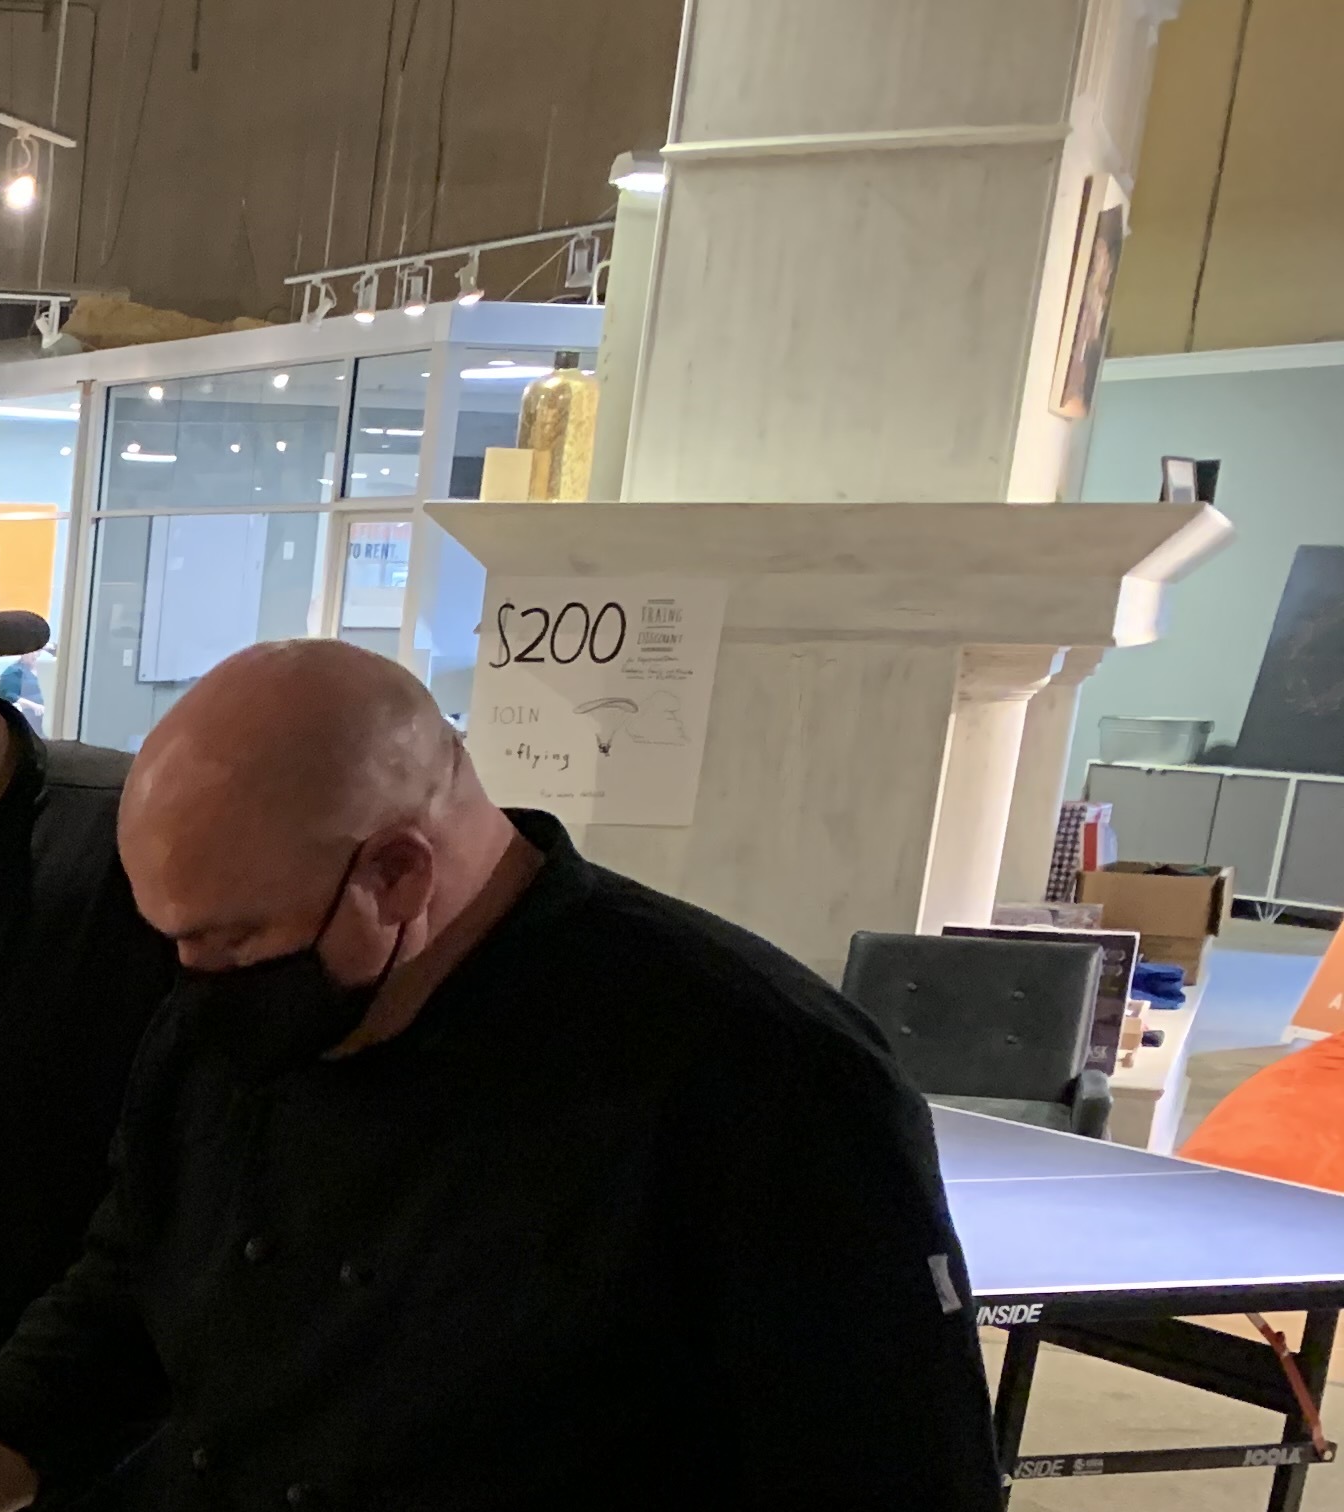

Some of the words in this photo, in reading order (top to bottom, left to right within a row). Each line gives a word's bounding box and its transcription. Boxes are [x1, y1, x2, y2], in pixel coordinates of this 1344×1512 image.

[489, 597, 626, 669] $200
[489, 705, 540, 725] JOIN
[976, 1303, 1044, 1325] INSIDE
[1243, 1447, 1302, 1467] JOOLA
